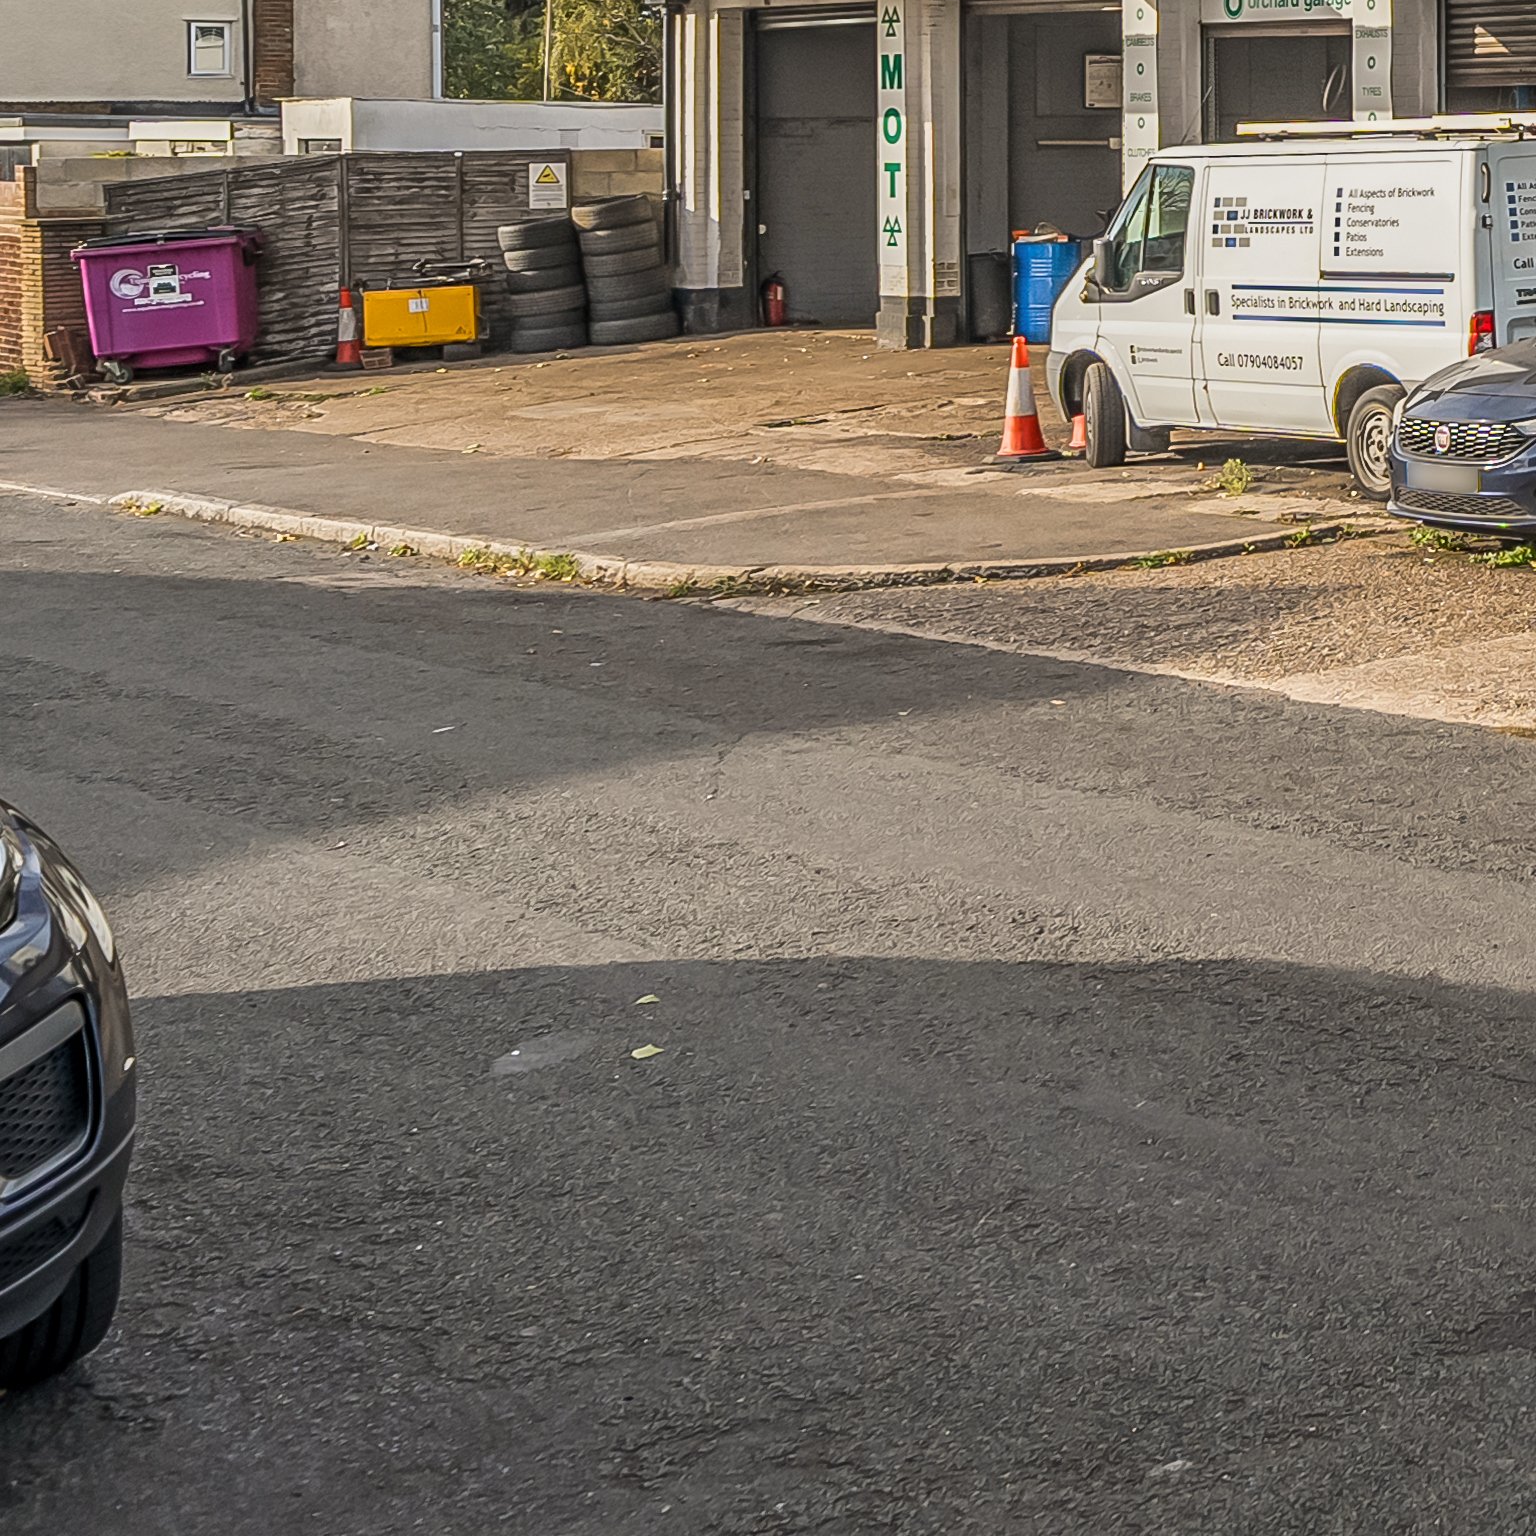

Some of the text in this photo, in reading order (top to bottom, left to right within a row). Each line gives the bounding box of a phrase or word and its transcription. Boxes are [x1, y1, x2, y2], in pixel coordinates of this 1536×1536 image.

[1362, 86, 1382, 97] TYRES
[1129, 92, 1152, 103] BRAKES
[881, 54, 902, 198] MOT
[1517, 182, 1527, 190] All
[1348, 187, 1435, 201] All Aspects of Brickwork
[1240, 208, 1313, 220] JJ BRICKWORK &
[1347, 203, 1375, 215] Fencing
[1346, 217, 1400, 228] Conservatories
[1244, 226, 1313, 234] LANDSCAPES LTD
[1346, 232, 1367, 242] Patios
[1346, 247, 1384, 257] Extensions
[1513, 258, 1534, 270] Call
[1231, 295, 1445, 316] Specialists in Brickwork and Hard Landscaping
[1217, 353, 1304, 370] Call 07904084057
